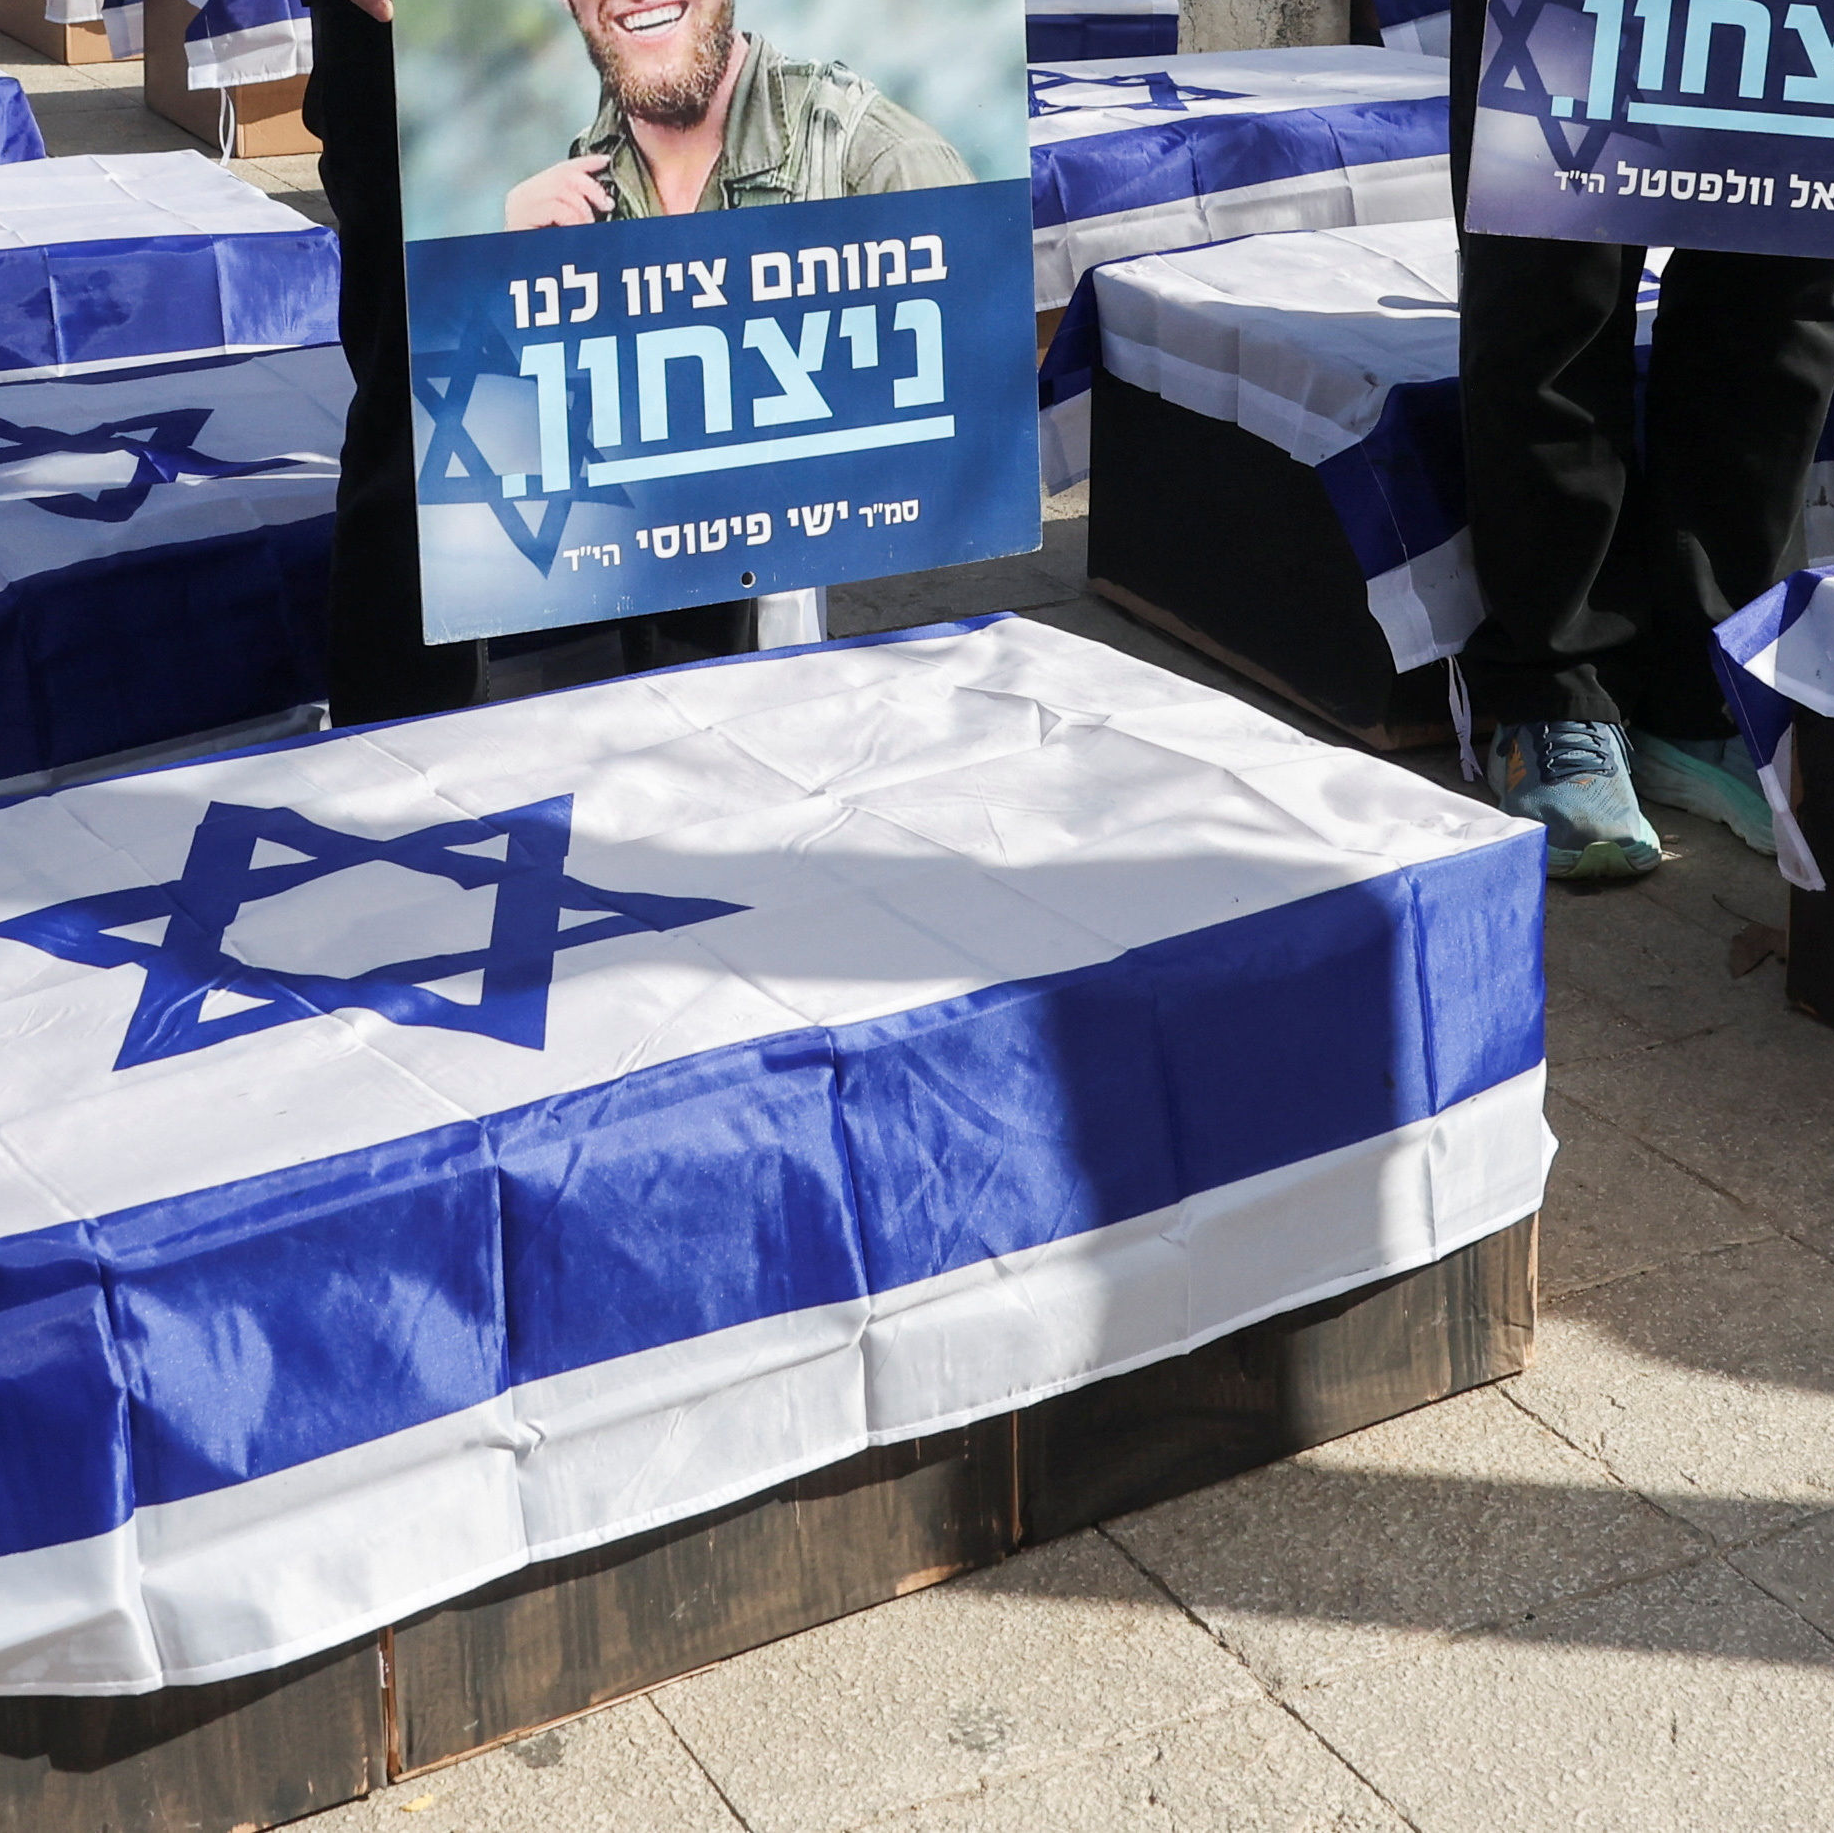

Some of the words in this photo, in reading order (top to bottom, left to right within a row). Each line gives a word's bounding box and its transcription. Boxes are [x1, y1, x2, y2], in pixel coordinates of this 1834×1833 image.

[1616, 161, 1775, 207] וולפסטל
[508, 264, 600, 330] לנו
[621, 257, 728, 317] ציוו
[751, 234, 949, 302] במותם
[501, 297, 946, 499] ניצחון.
[635, 512, 773, 561] פיטוסי
[786, 500, 850, 537] ישי
